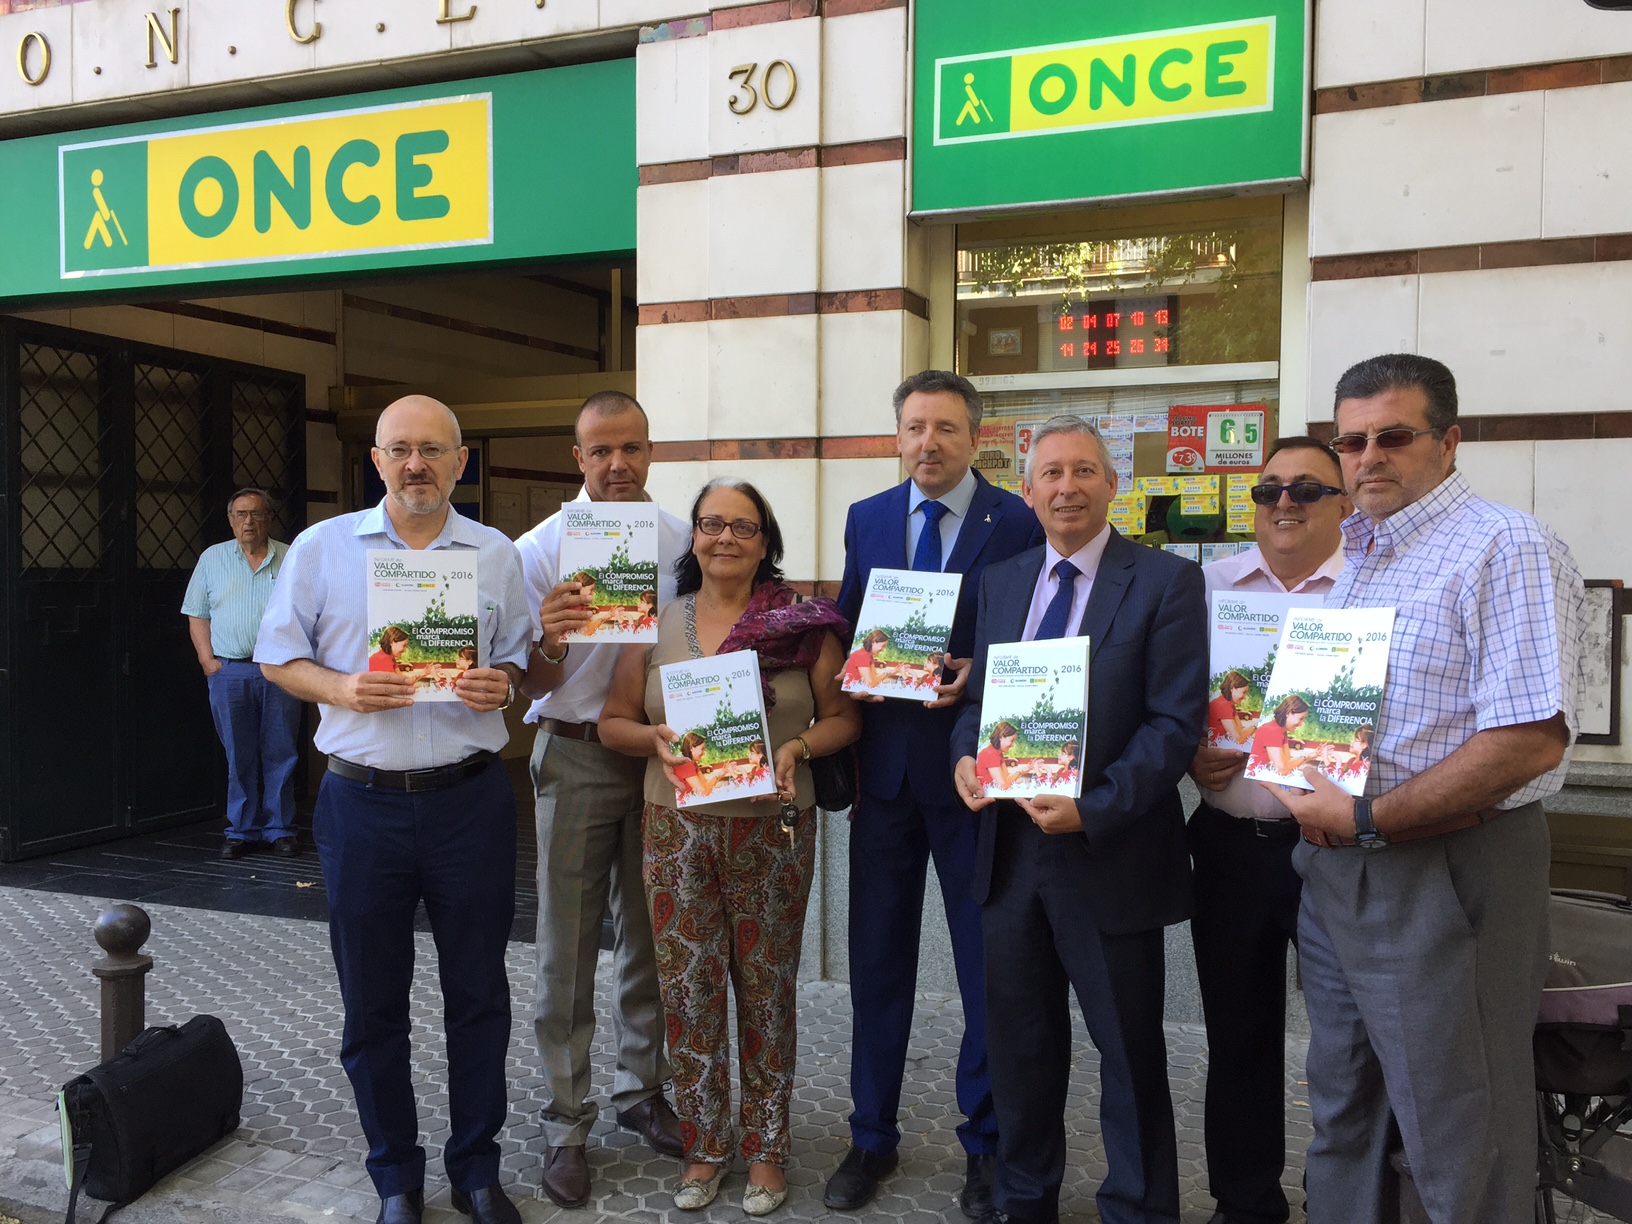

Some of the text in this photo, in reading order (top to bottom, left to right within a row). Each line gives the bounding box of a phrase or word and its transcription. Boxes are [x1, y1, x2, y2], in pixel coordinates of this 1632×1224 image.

[1029, 39, 1249, 116] ONCE
[728, 58, 798, 115] 30
[178, 129, 451, 239] ONCE
[1060, 316, 1074, 330] 02
[1106, 312, 1120, 328] 07
[1130, 311, 1144, 326] 10
[1154, 310, 1168, 324] 13
[1106, 340, 1120, 354] 25
[1130, 338, 1144, 353] 26
[1171, 426, 1204, 437] BOTE
[980, 450, 1001, 460] EURO
[974, 458, 1010, 469] JACKPOT
[567, 520, 654, 528] COMPARTIDO 2016
[374, 562, 404, 570] VALOR
[374, 570, 473, 580] COMPARTIDO 2016
[606, 572, 654, 580] COMPROMISO
[874, 578, 899, 586] VALOR
[872, 584, 924, 594] COMPARTIDO
[1218, 604, 1247, 612] VALOR
[1218, 612, 1279, 622] COMPARTIDO
[420, 627, 474, 635] COMPROMISO
[1292, 622, 1323, 631] VALOR
[899, 632, 946, 643] COMPROMISO
[1290, 630, 1352, 642] COMPARTIDO
[1366, 632, 1387, 641] 2016
[904, 644, 943, 652] DIFERENCIA
[992, 665, 1082, 674] COMPARTIDO 2016
[667, 672, 692, 682] VALOR
[668, 675, 720, 690] COMPARTIDO
[732, 669, 750, 680] 2016
[1322, 699, 1376, 711] COMPROMISO
[1317, 707, 1341, 715] marca
[1327, 715, 1373, 726] DIFERENCIA
[714, 722, 759, 736] COMPROMISO
[1028, 722, 1078, 730] COMPROMISO
[722, 734, 761, 746] DIFERENCIA
